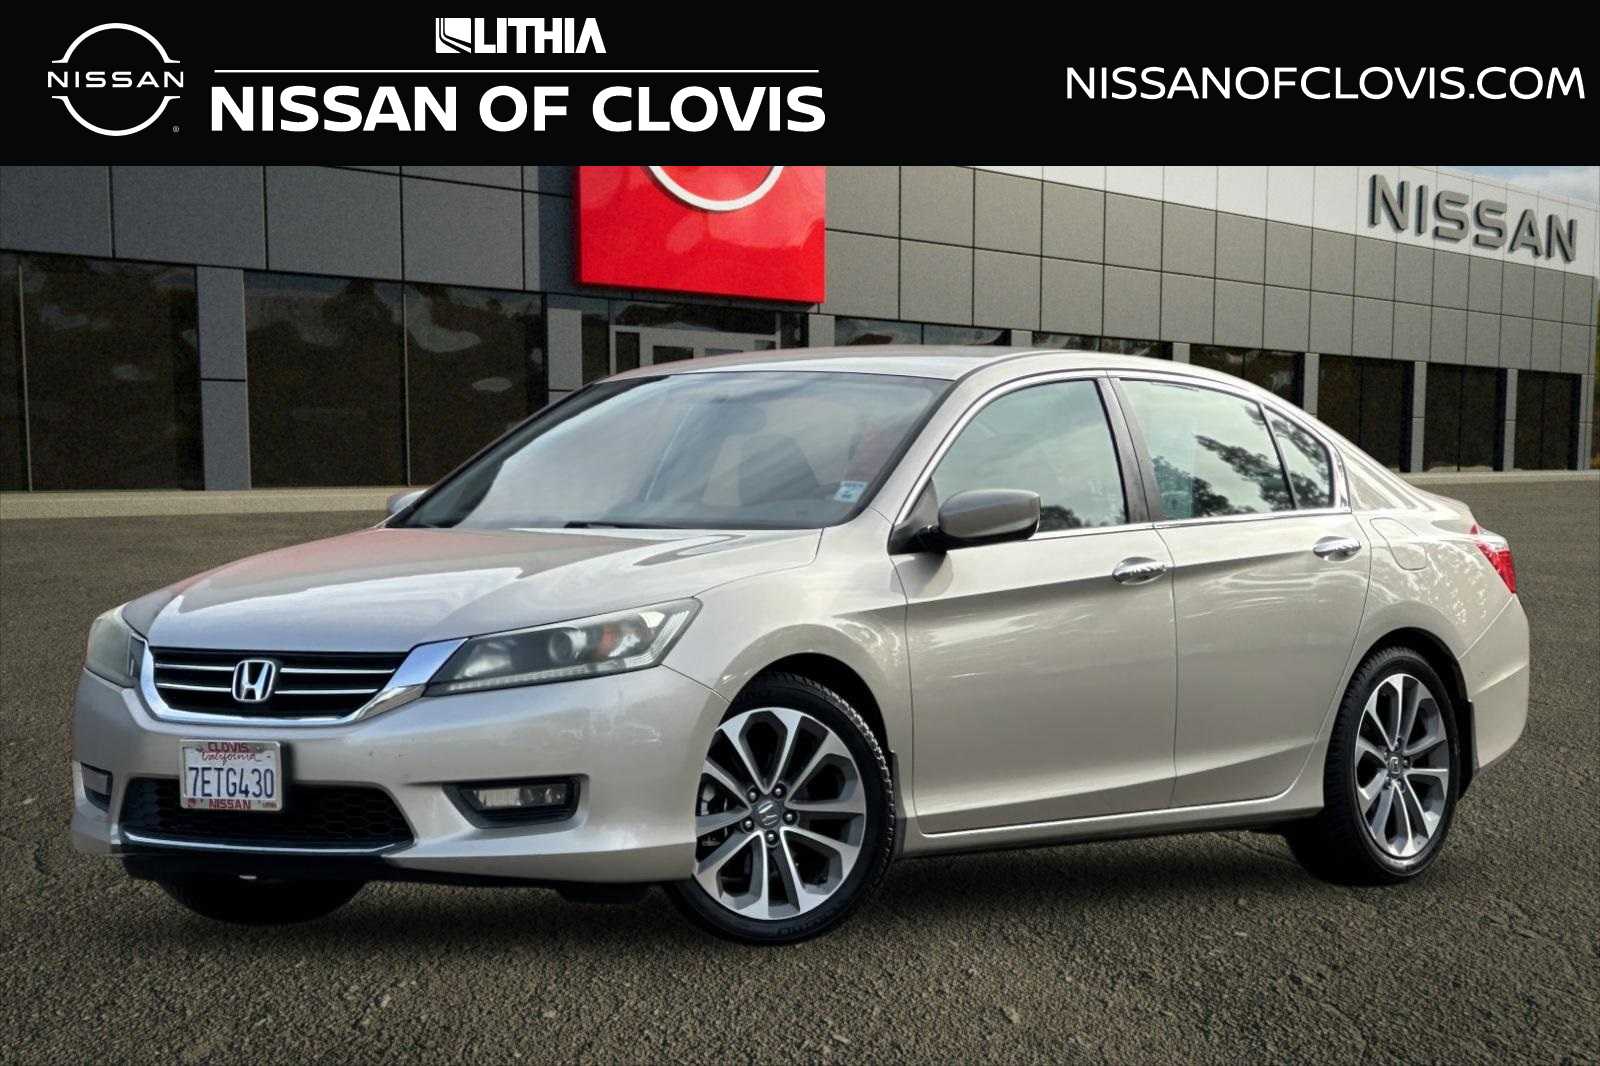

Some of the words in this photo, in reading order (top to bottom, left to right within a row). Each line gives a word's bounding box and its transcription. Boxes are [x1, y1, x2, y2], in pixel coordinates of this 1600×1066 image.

[1368, 173, 1578, 264] NISSAN
[207, 742, 249, 753] CLOVIS
[188, 766, 275, 798] 7ETG430
[208, 798, 252, 810] NISSAN
